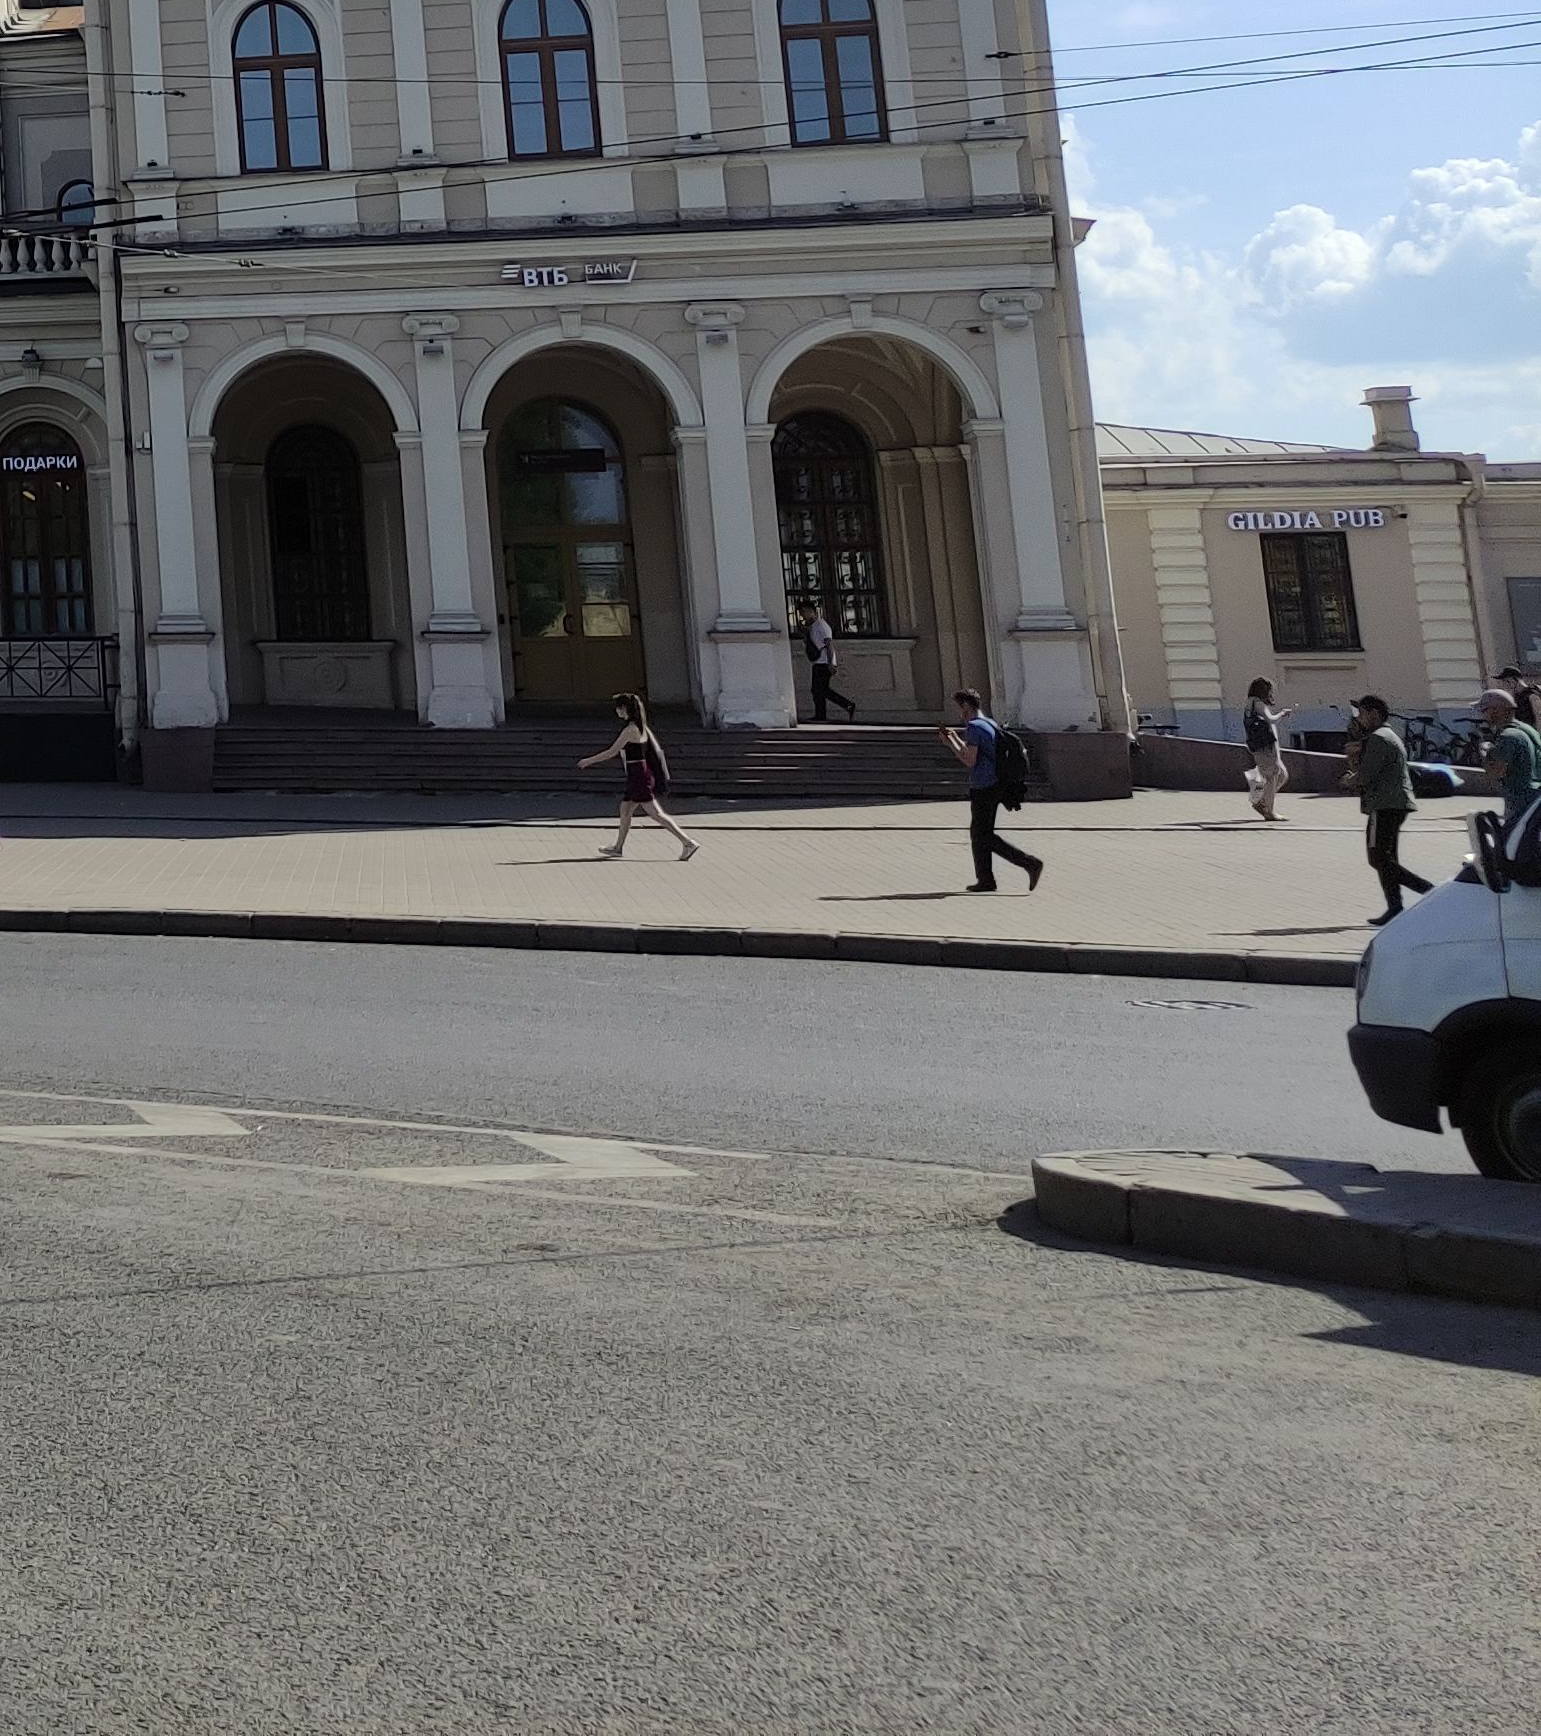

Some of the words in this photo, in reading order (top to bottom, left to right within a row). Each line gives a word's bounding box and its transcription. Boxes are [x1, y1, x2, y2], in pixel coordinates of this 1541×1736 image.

[523, 266, 568, 287] ВТБ
[585, 263, 622, 275] БАНК
[2, 455, 77, 471] ПОДАРКИ
[1227, 510, 1323, 530] GILDIA
[1332, 509, 1384, 528] PUB
